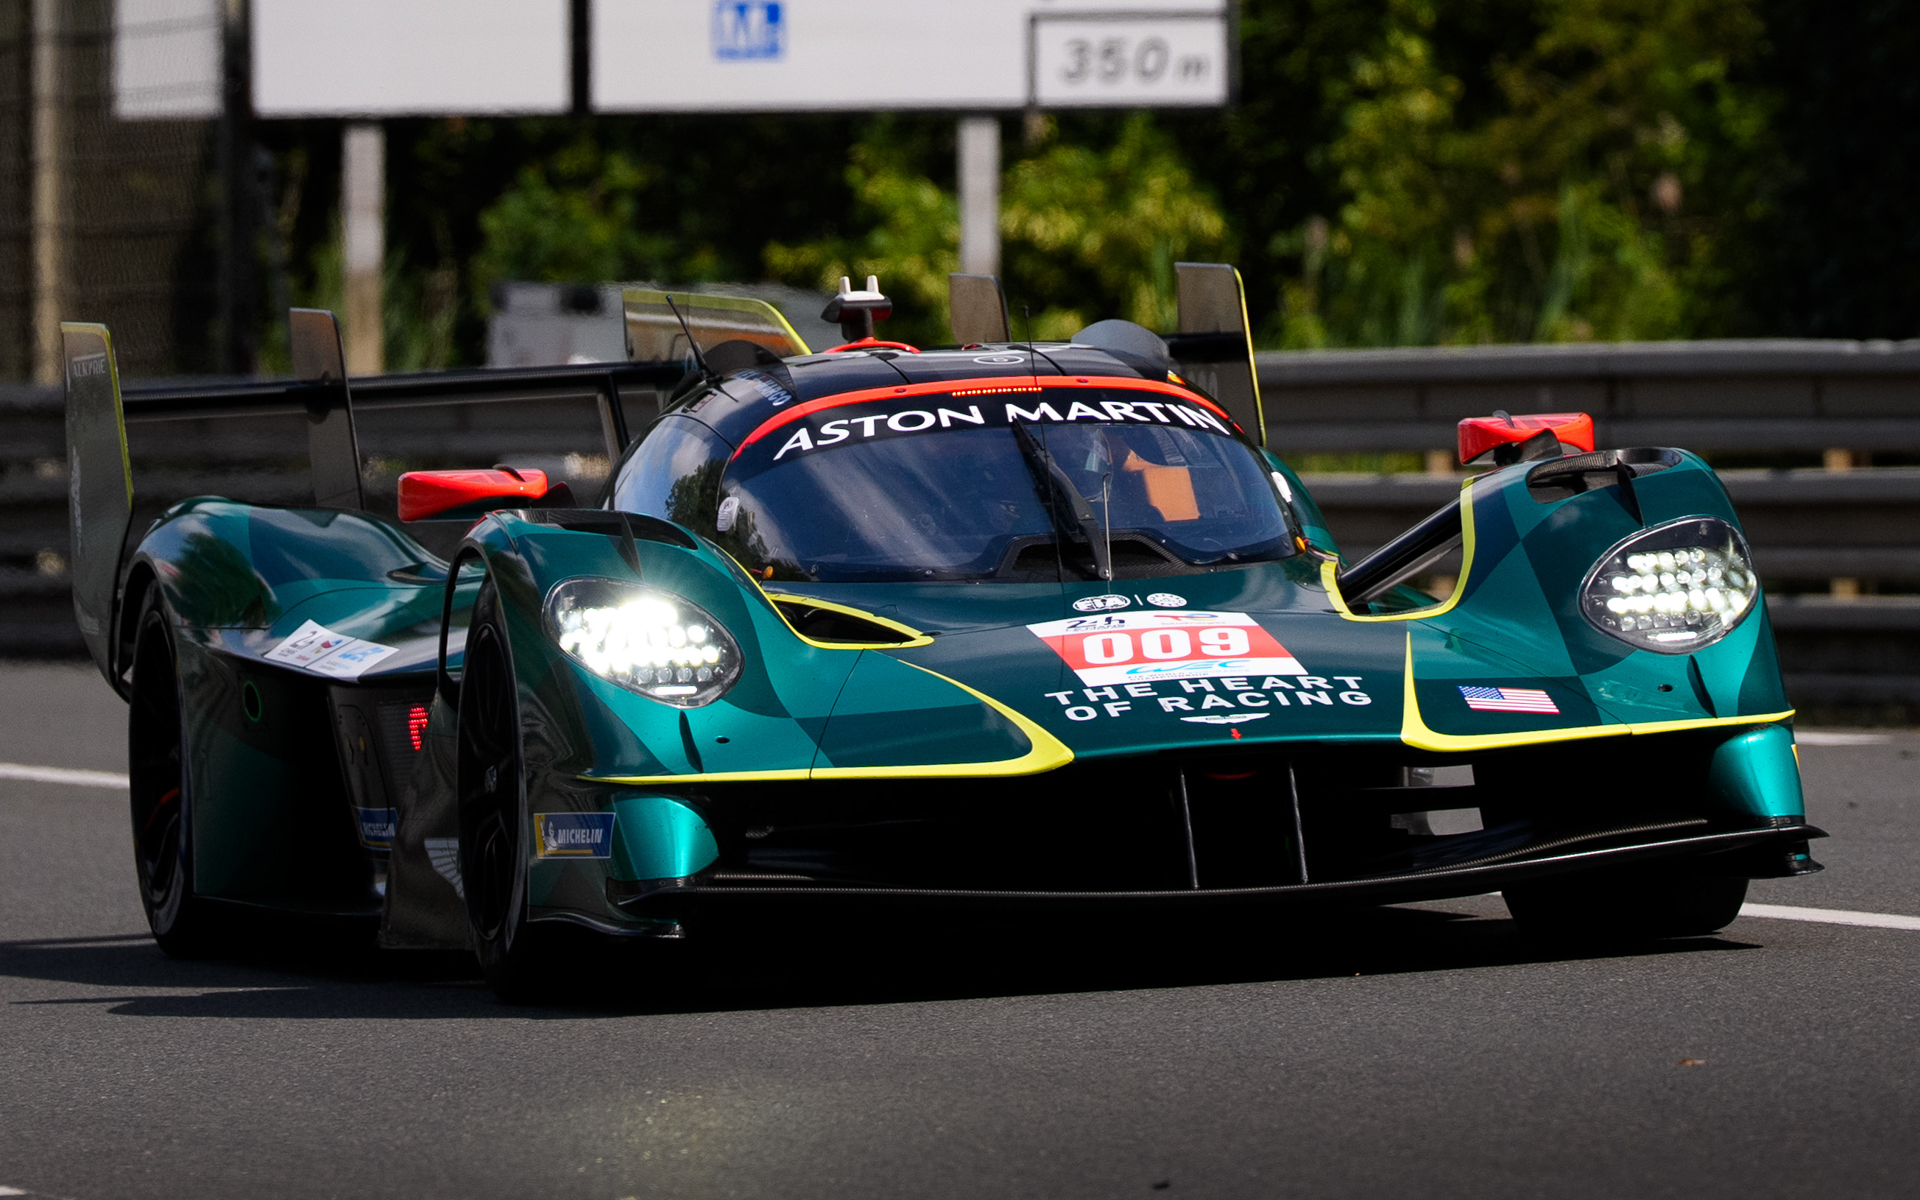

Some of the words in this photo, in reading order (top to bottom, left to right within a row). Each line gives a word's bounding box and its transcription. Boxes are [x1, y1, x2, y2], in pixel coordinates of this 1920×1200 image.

[1057, 36, 1171, 84] 350
[1174, 54, 1211, 82] m
[774, 405, 985, 460] ASTON
[1005, 402, 1231, 436] MARTIN
[1082, 628, 1250, 664] 009
[1045, 683, 1158, 706] THE
[1179, 676, 1363, 695] HEART
[1065, 701, 1132, 722] OF
[1158, 691, 1372, 713] RACING
[557, 828, 603, 844] MICHELIN
